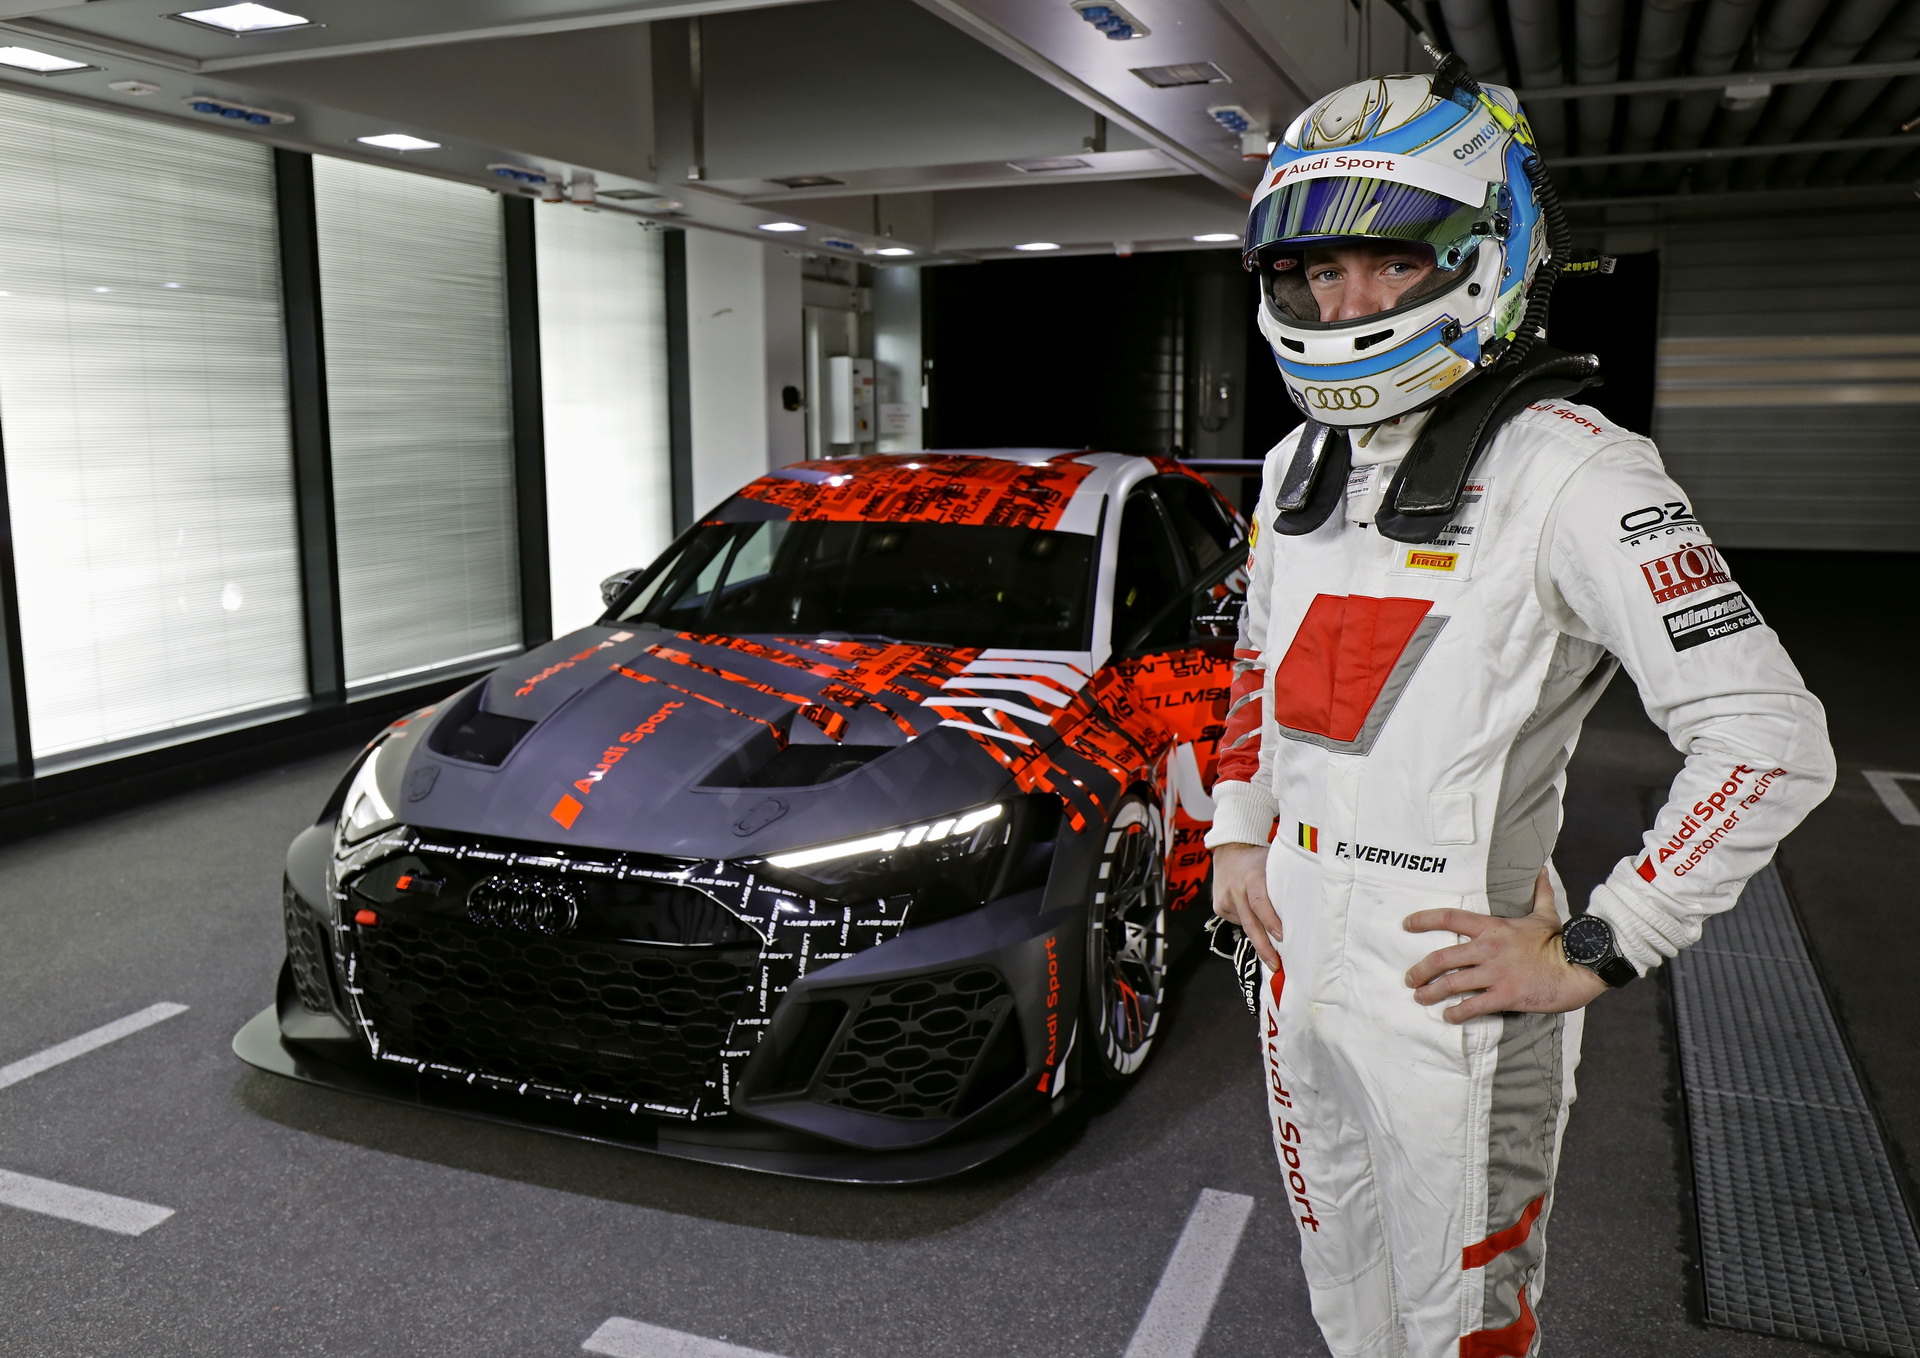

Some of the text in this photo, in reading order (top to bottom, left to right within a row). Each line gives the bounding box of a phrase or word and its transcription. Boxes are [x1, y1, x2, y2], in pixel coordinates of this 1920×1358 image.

[1453, 117, 1500, 160] comtoy
[1287, 156, 1395, 177] Audi Sport
[1452, 365, 1462, 377] 22
[1553, 409, 1603, 435] Sport
[1440, 525, 1475, 535] LLENGE
[1411, 553, 1454, 567] PIRELLI
[1707, 614, 1757, 637] Brake Pads
[573, 701, 684, 794] Audi Sport
[1658, 764, 1754, 863] Audi Sport
[1674, 768, 1787, 876] customer racing
[1335, 842, 1447, 873] F. VERVISCH
[1045, 936, 1060, 1066] Audi Sport
[1267, 1006, 1320, 1233] Audi Sport
